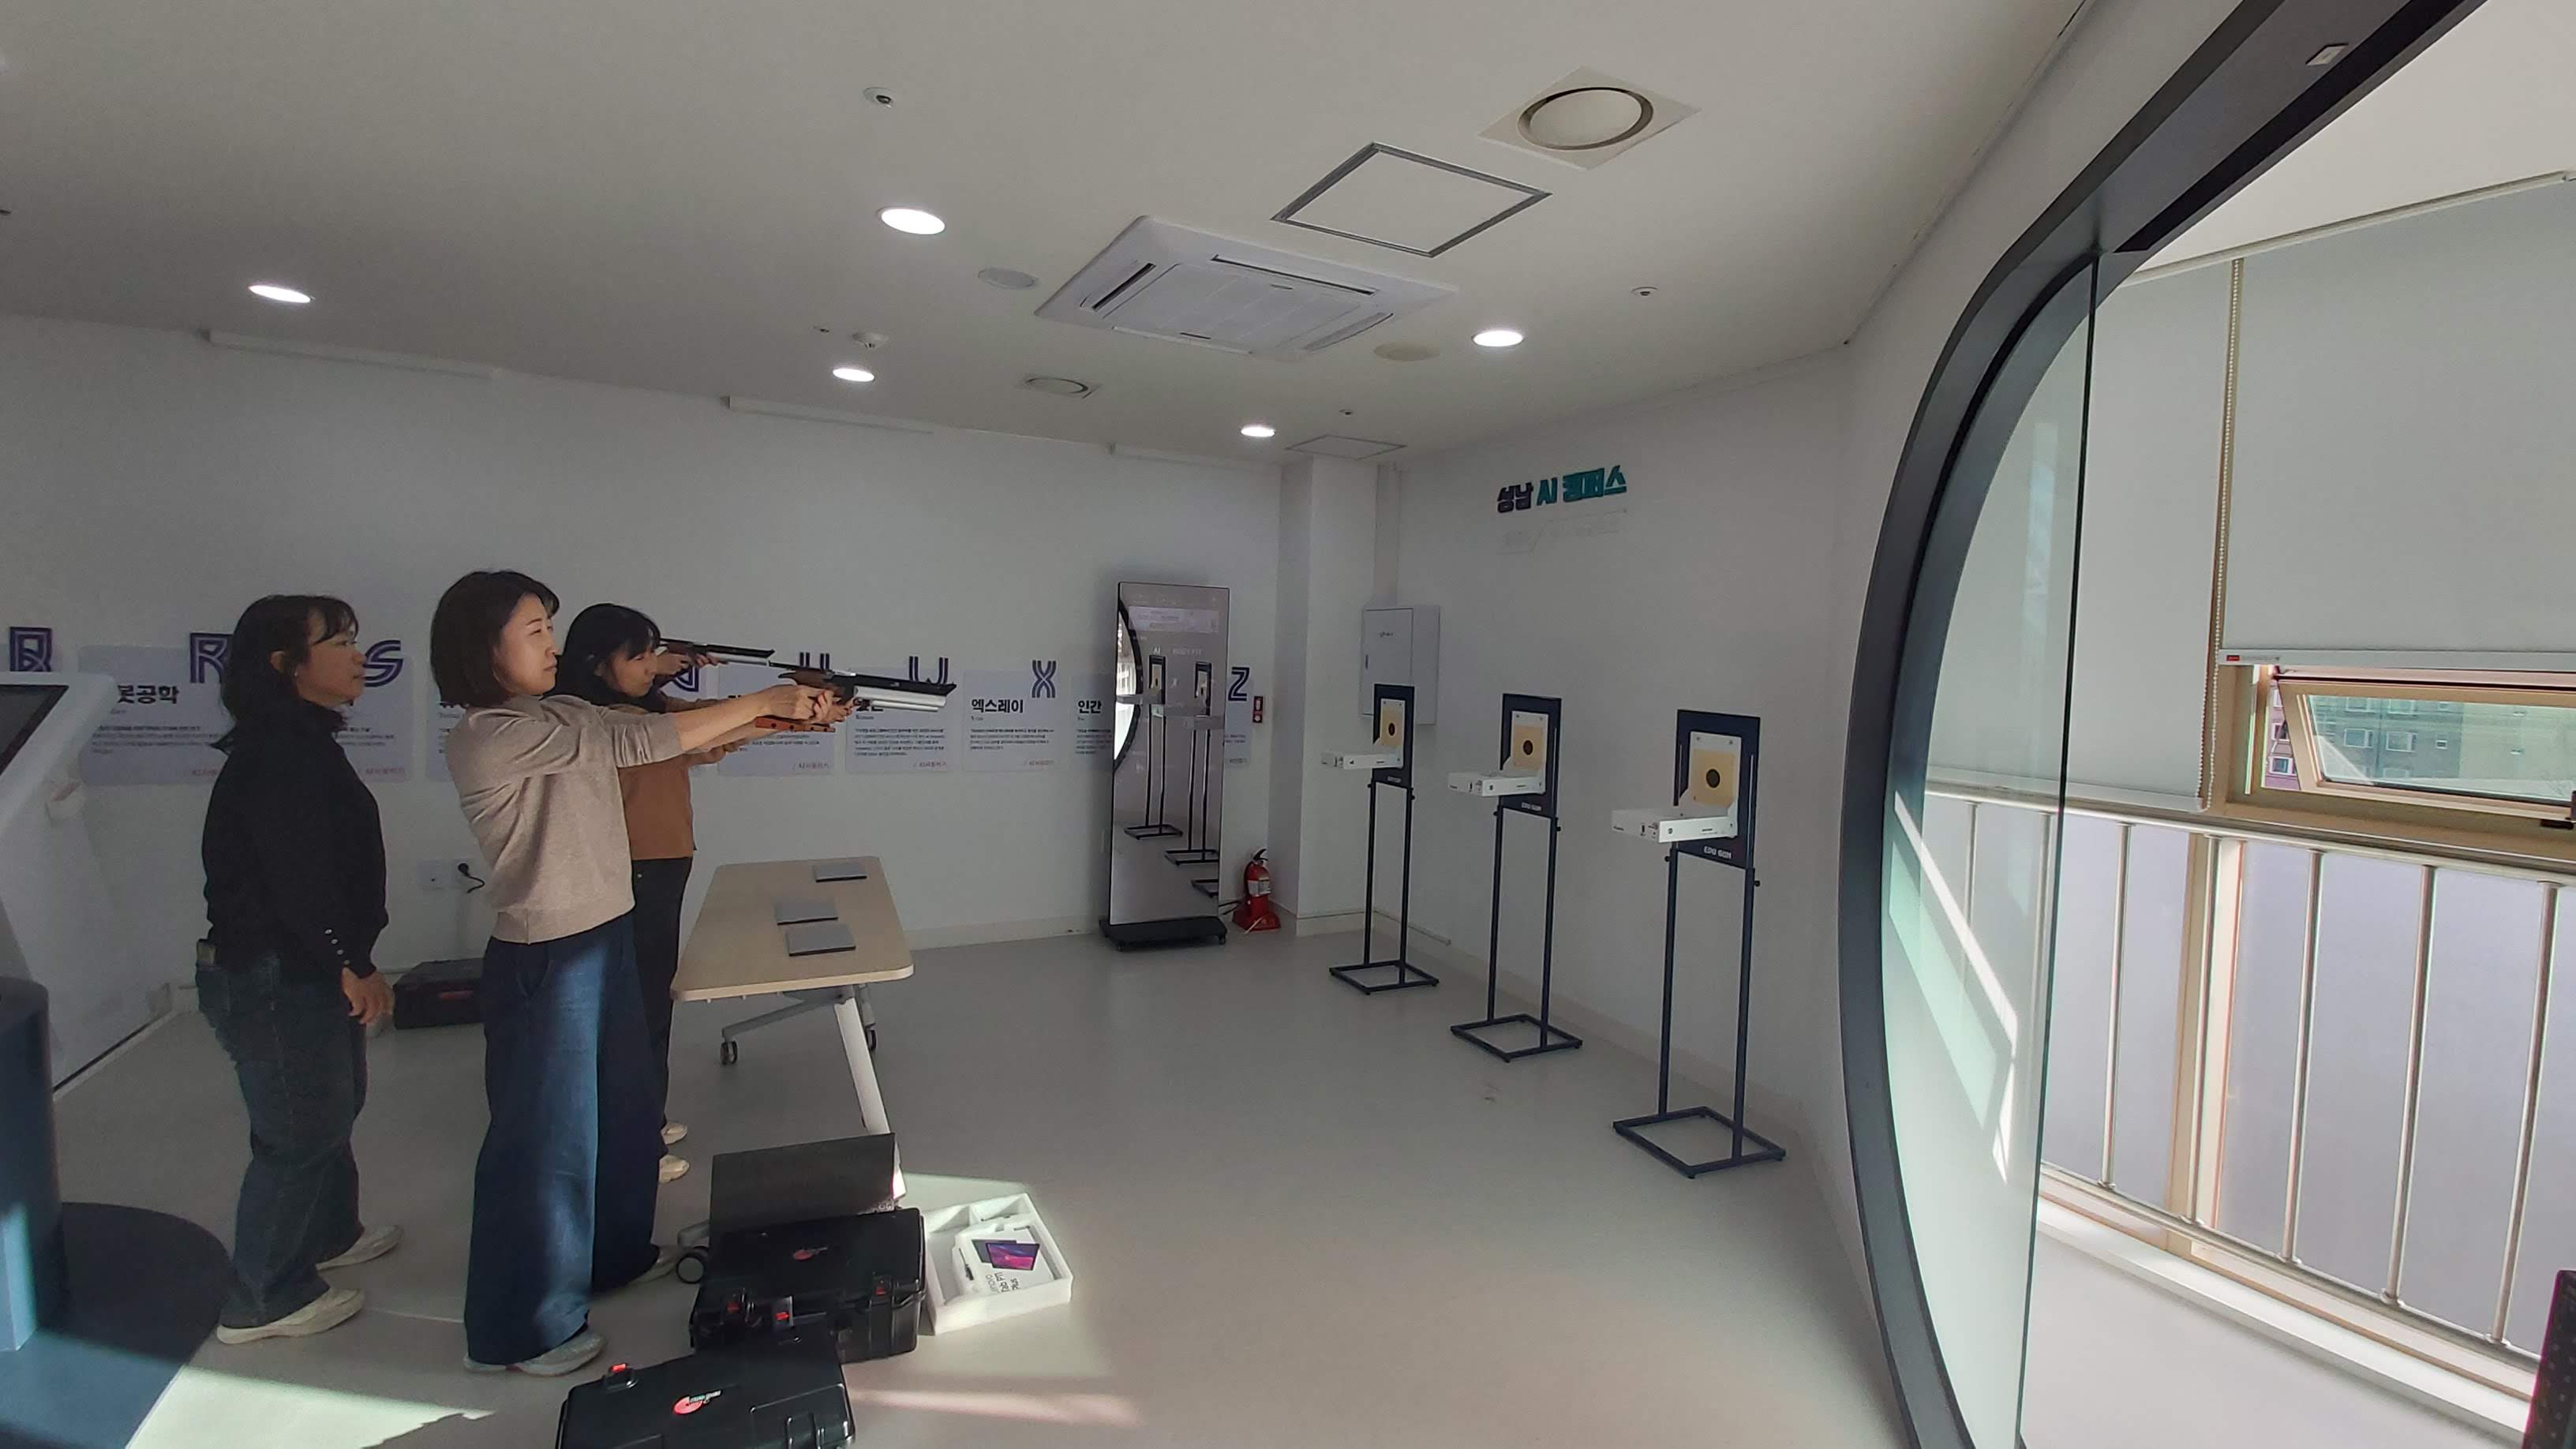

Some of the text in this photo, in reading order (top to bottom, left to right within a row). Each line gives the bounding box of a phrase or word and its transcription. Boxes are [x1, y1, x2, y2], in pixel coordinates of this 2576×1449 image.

[1496, 465, 1627, 513] 성남 AI 캠퍼스
[189, 633, 234, 683] R
[365, 640, 404, 687] S
[1032, 660, 1057, 698] X
[1227, 667, 1250, 702] Z
[972, 698, 1024, 713] 엑스레이
[1078, 700, 1102, 714] 인간
[1703, 845, 1717, 856] EDU
